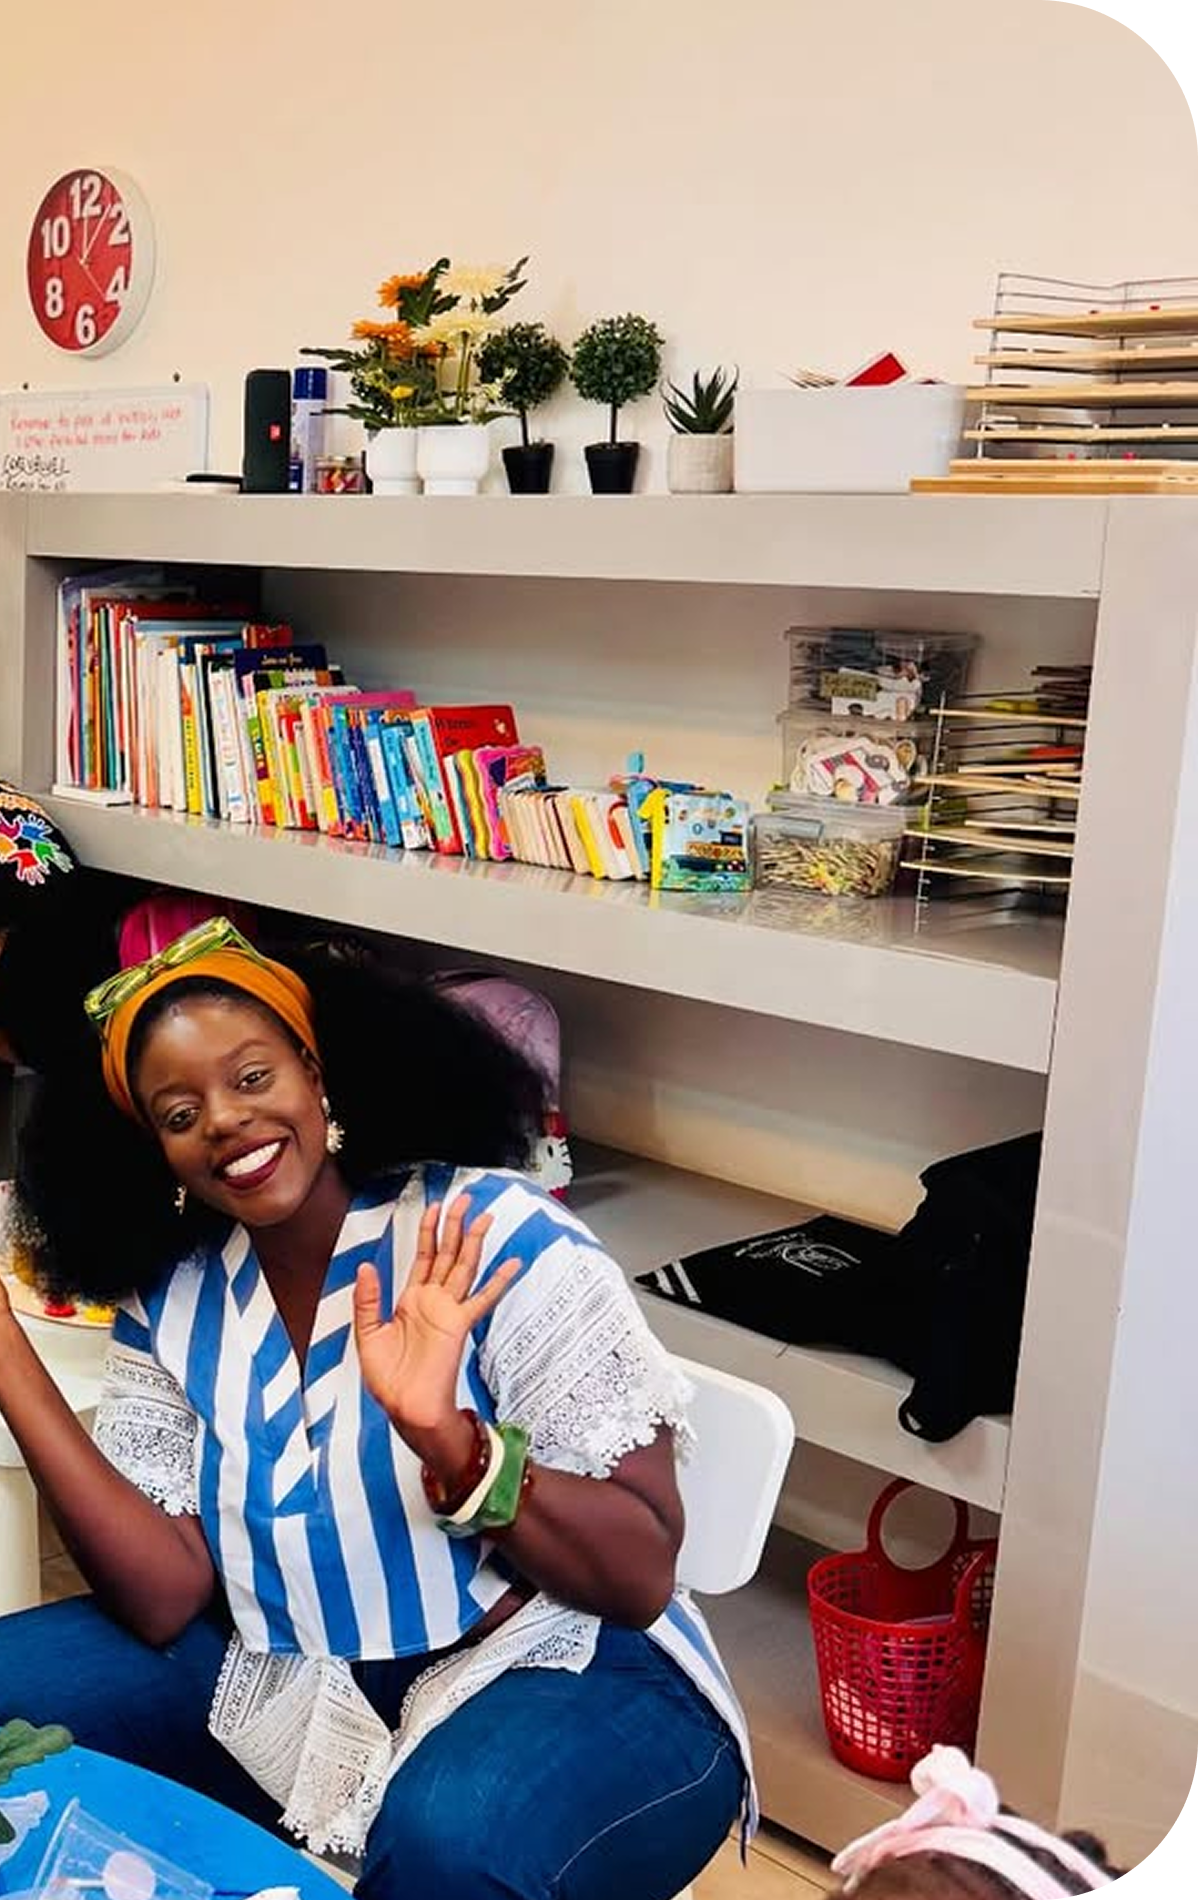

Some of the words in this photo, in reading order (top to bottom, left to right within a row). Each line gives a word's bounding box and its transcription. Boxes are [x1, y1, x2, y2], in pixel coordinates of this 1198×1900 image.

[70, 174, 103, 219] 12
[41, 215, 71, 259] 10
[108, 203, 130, 246] 2
[45, 276, 64, 319] 8
[105, 266, 125, 307] 4
[75, 303, 96, 345] 6
